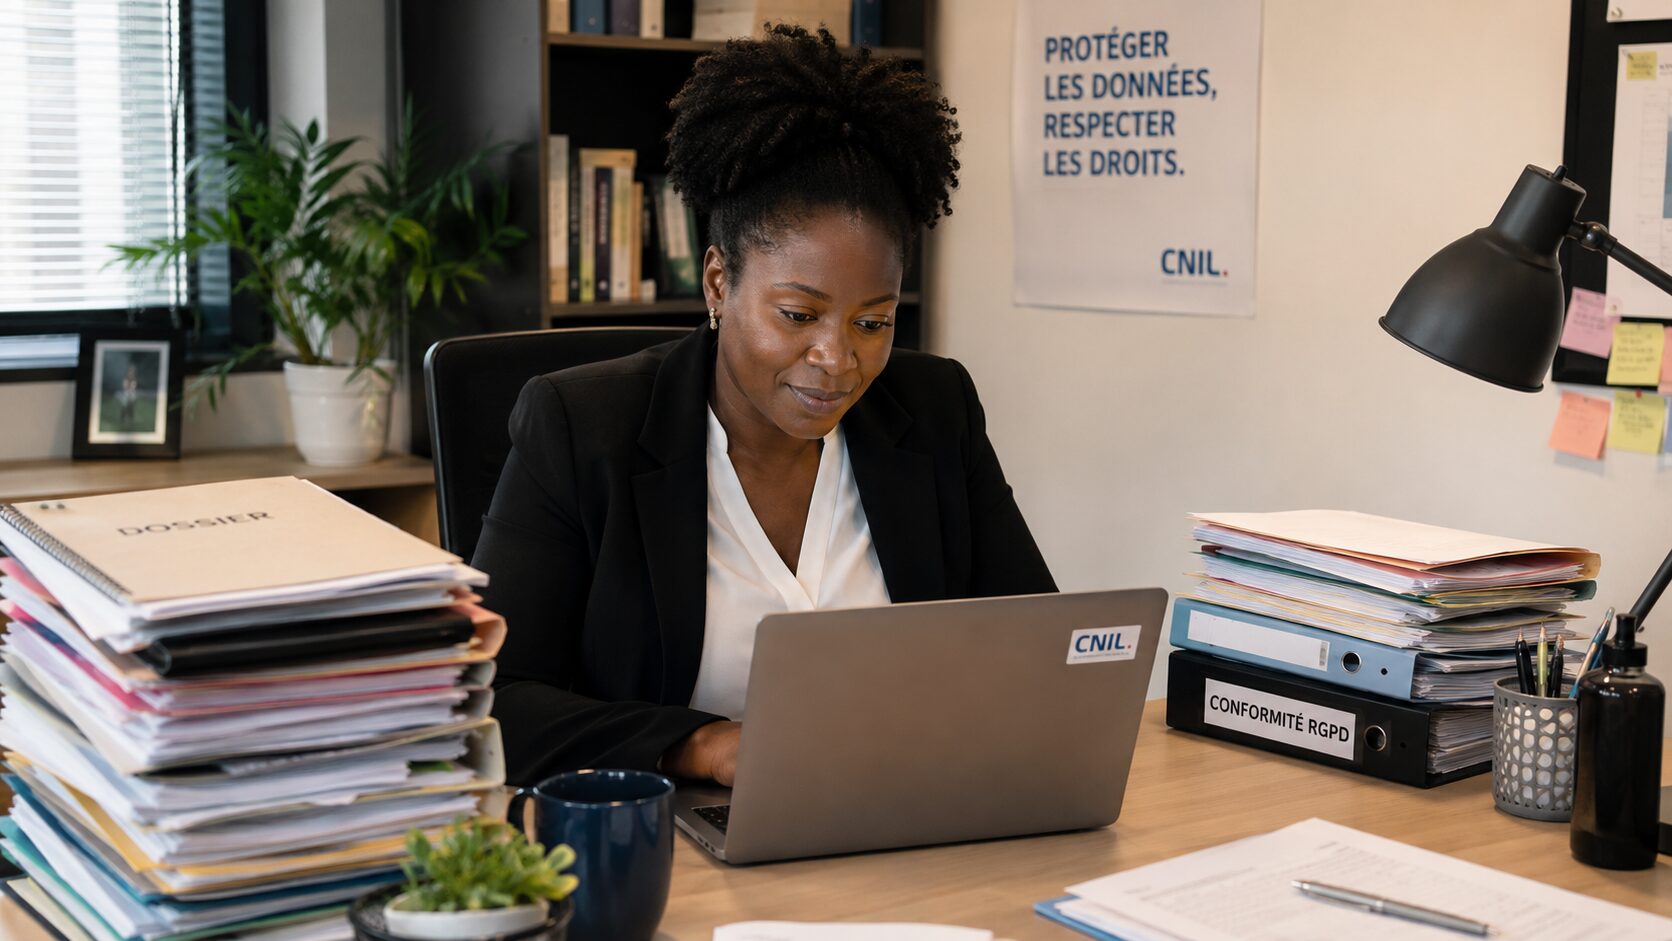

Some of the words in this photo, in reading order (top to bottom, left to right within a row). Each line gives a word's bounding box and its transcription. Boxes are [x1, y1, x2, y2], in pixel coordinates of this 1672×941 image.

[1045, 26, 1169, 63] PROTÉGER
[1045, 74, 1084, 101] LES
[1092, 63, 1217, 101] DONNÉES,
[1044, 110, 1175, 138] RESPECTER
[1043, 150, 1082, 177] LES
[1090, 149, 1185, 177] DROITS.
[1161, 249, 1228, 277] CNIL.
[117, 511, 273, 536] DOSSIER
[1075, 633, 1131, 653] CNIL.
[1210, 694, 1303, 732] CONFORMITÉ
[1308, 719, 1350, 742] RGPD
